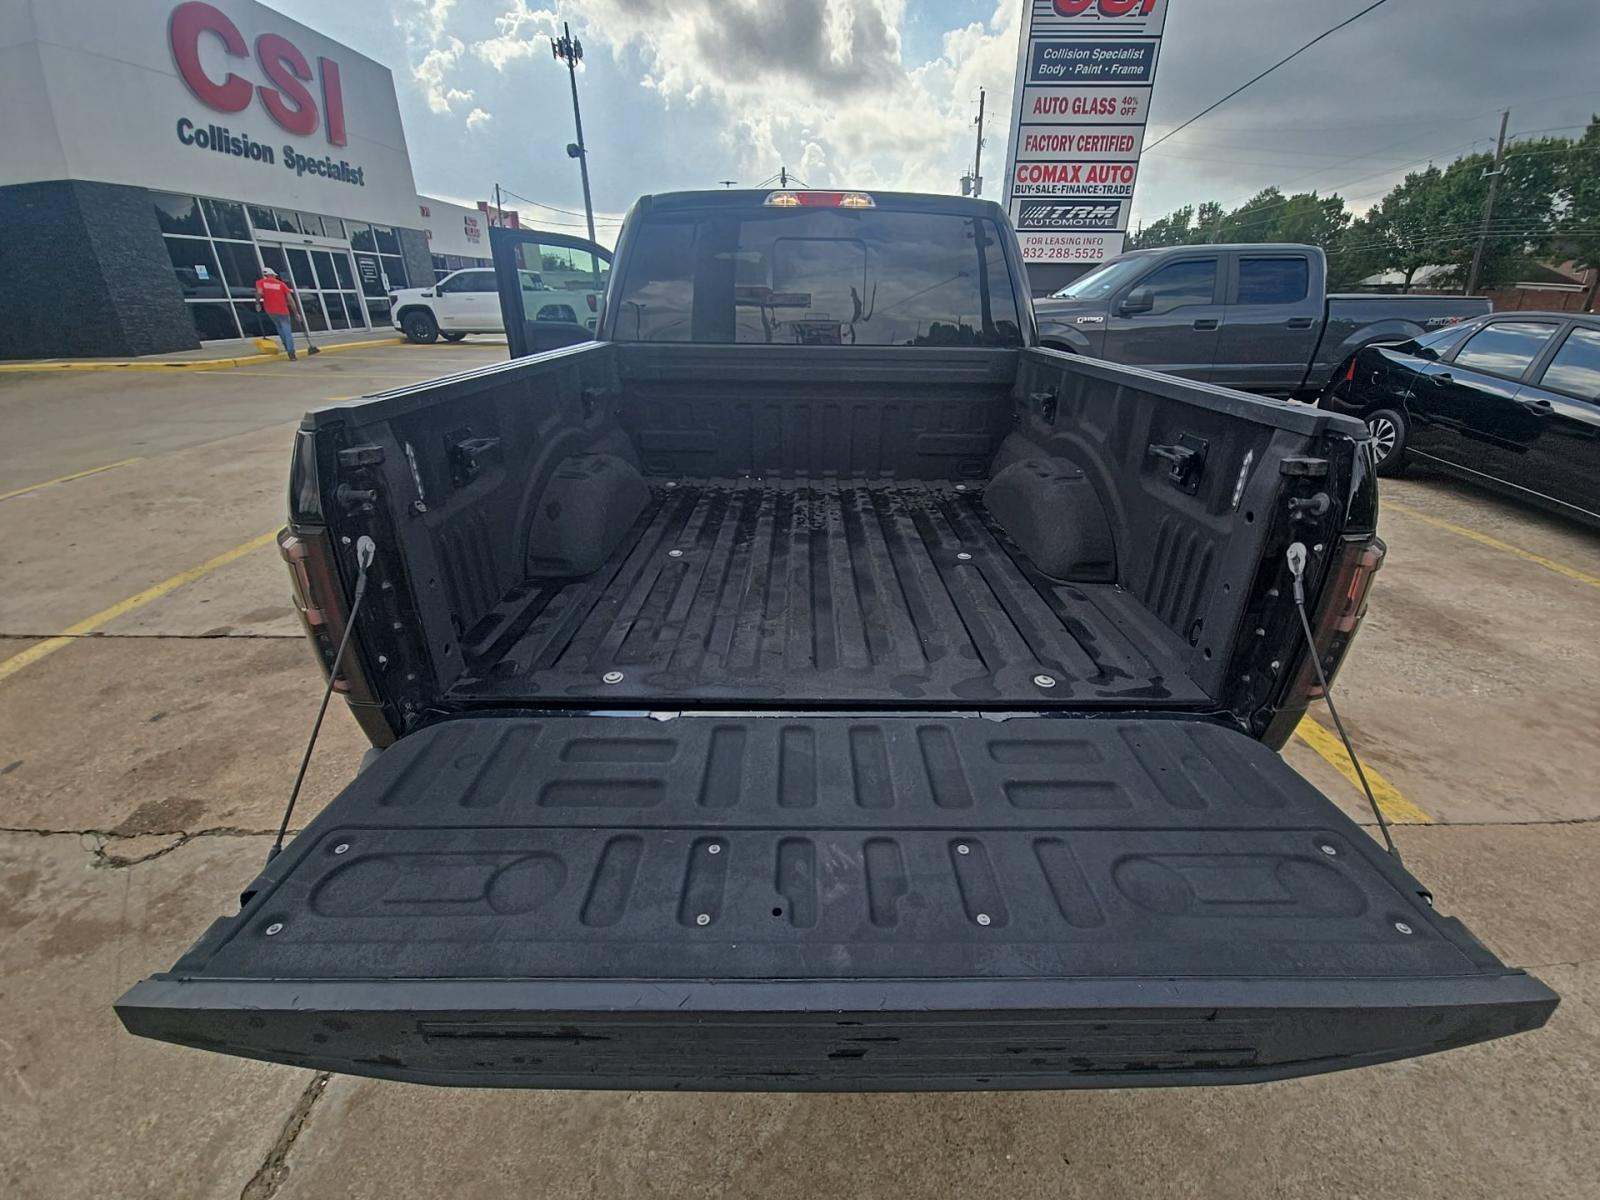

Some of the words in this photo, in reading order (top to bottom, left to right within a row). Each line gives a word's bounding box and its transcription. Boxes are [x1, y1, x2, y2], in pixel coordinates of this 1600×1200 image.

[1043, 48, 1090, 59] Collision
[1092, 48, 1145, 61] Specialist
[167, 1, 348, 148] CSI
[1038, 64, 1066, 77] Body
[1074, 64, 1103, 75] Paint
[1110, 64, 1144, 75] Frame
[1033, 96, 1069, 115] AUTO
[1072, 96, 1117, 116] GLASS
[1120, 107, 1137, 116] OFF
[1025, 134, 1076, 152] FACTORY
[1077, 135, 1135, 152] CERTIFIED
[176, 116, 275, 165] Collision
[282, 144, 366, 187] Specialist
[1016, 164, 1082, 184] COMAX
[1086, 164, 1135, 184] AUTO
[1024, 218, 1114, 226] AUTOMOTIVE
[1026, 237, 1044, 246] FOR
[1045, 237, 1081, 246] LEASING
[1082, 237, 1104, 246] INFO
[1023, 247, 1104, 260] 832-288-5525
